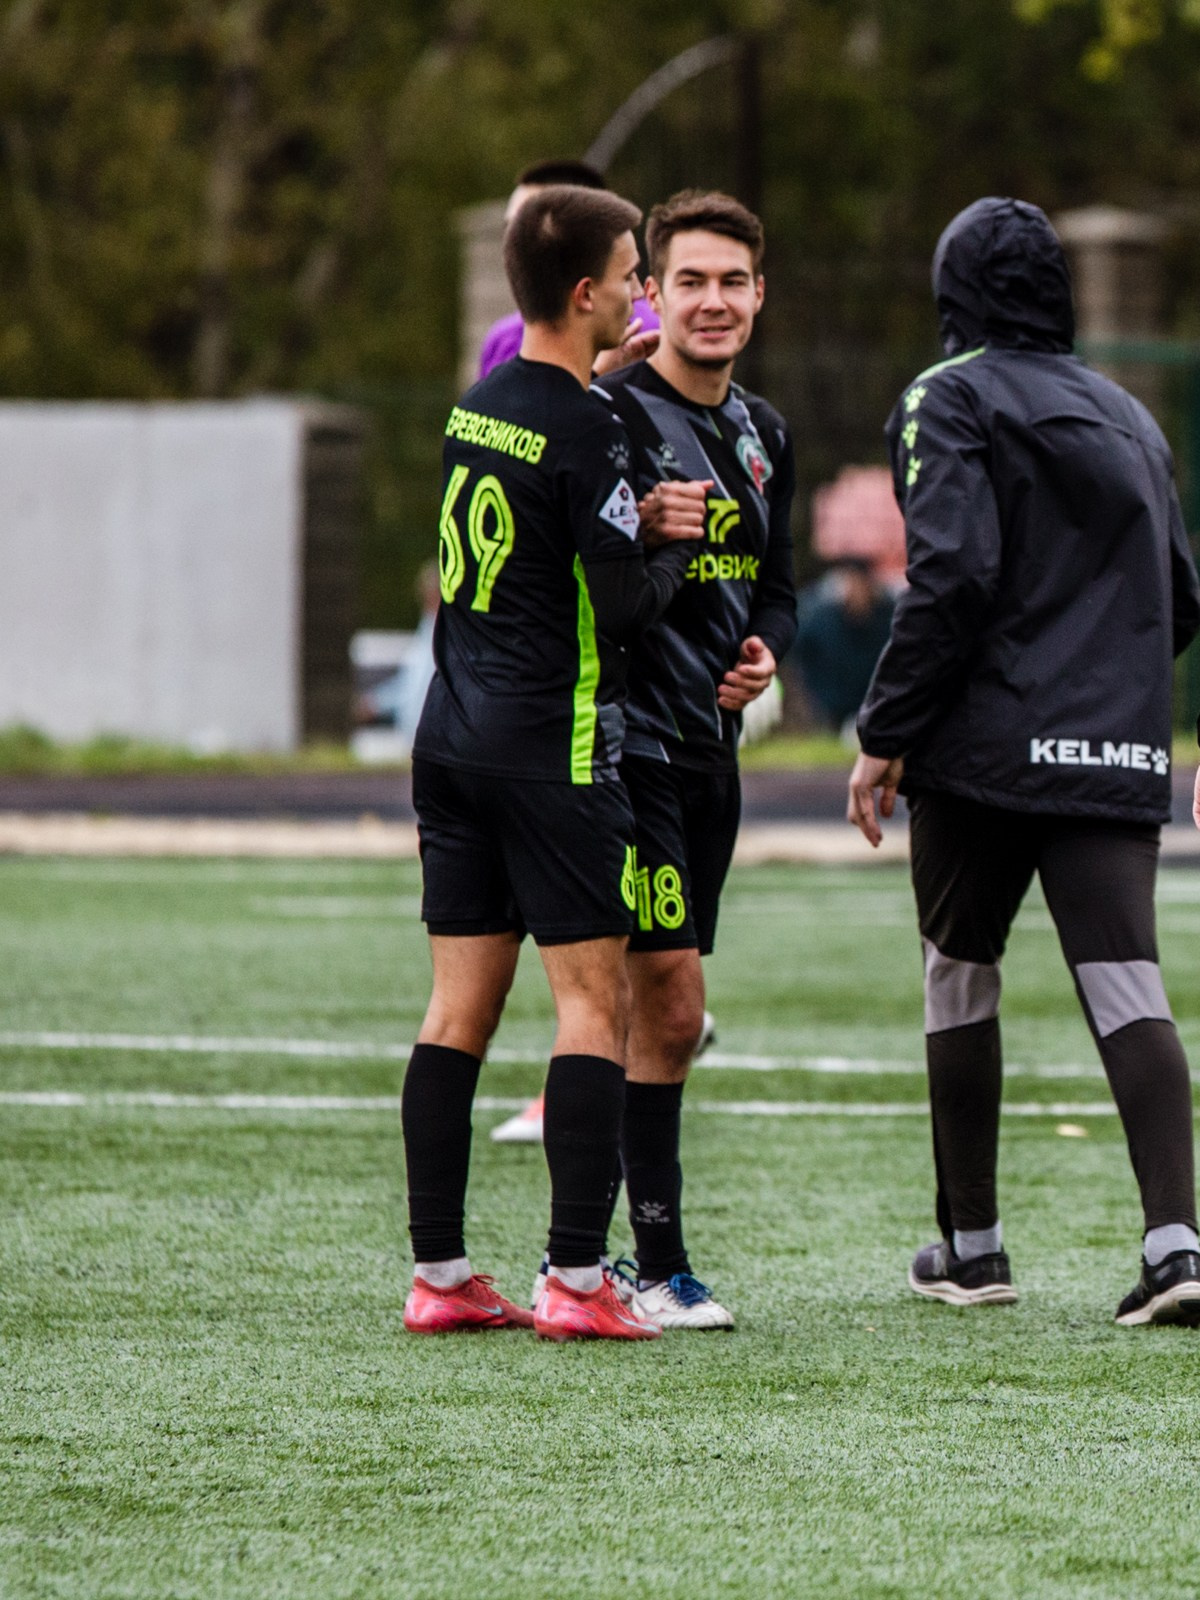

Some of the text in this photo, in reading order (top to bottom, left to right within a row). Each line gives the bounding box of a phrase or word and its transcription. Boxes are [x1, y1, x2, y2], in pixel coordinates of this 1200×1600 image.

[438, 463, 516, 613] 69
[1029, 737, 1152, 771] KELME
[635, 864, 687, 932] 18
